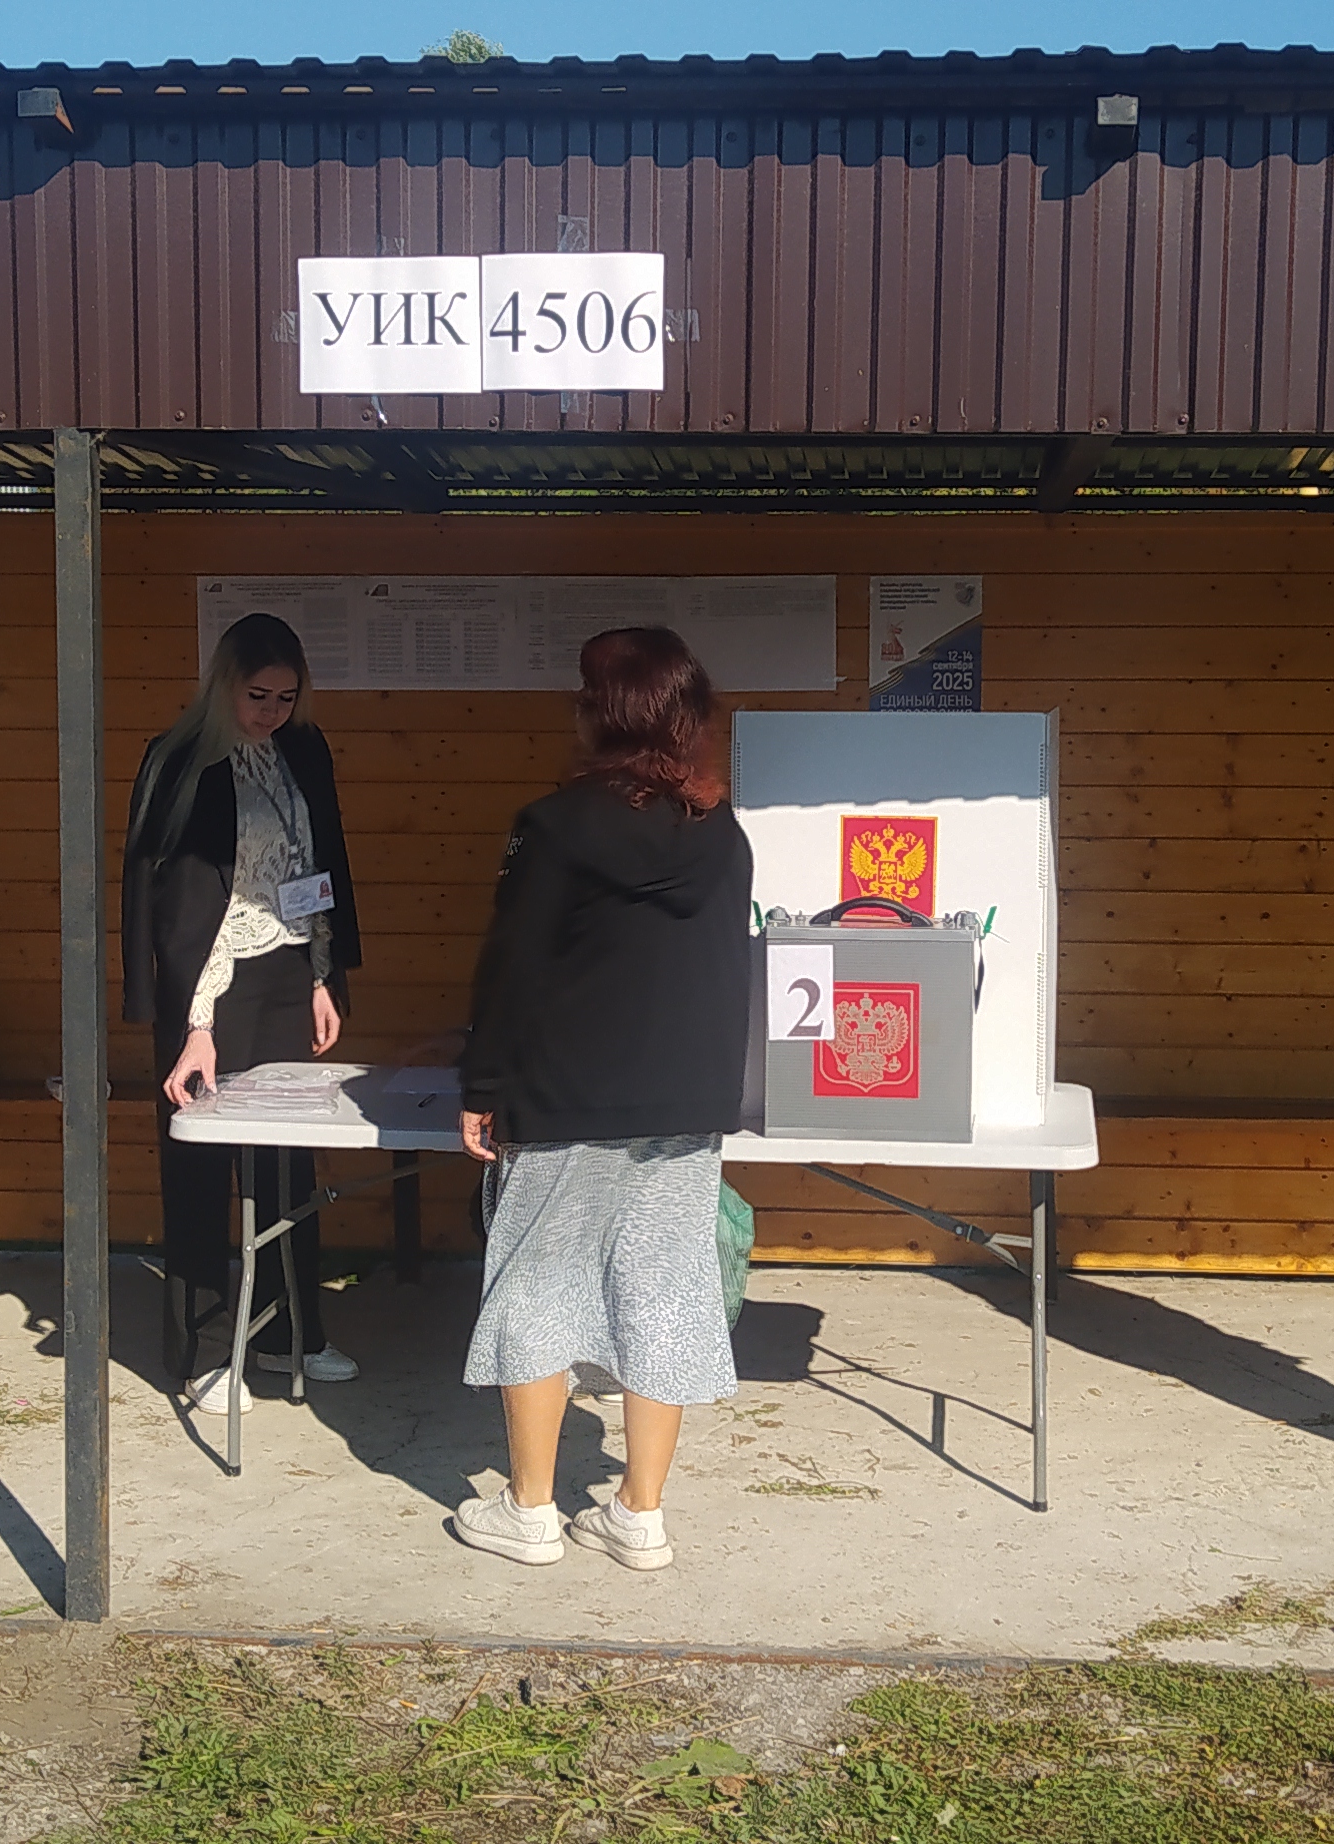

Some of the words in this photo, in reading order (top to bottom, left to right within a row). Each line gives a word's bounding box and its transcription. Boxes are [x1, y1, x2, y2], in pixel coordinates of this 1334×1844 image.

[312, 291, 470, 348] УИК
[488, 291, 658, 353] 4506
[933, 662, 973, 671] сентября
[932, 672, 973, 690] 2025
[880, 693, 934, 707] ЕДИНЫЙ
[938, 694, 973, 707] ДЕНЬ
[786, 977, 824, 1038] 2
